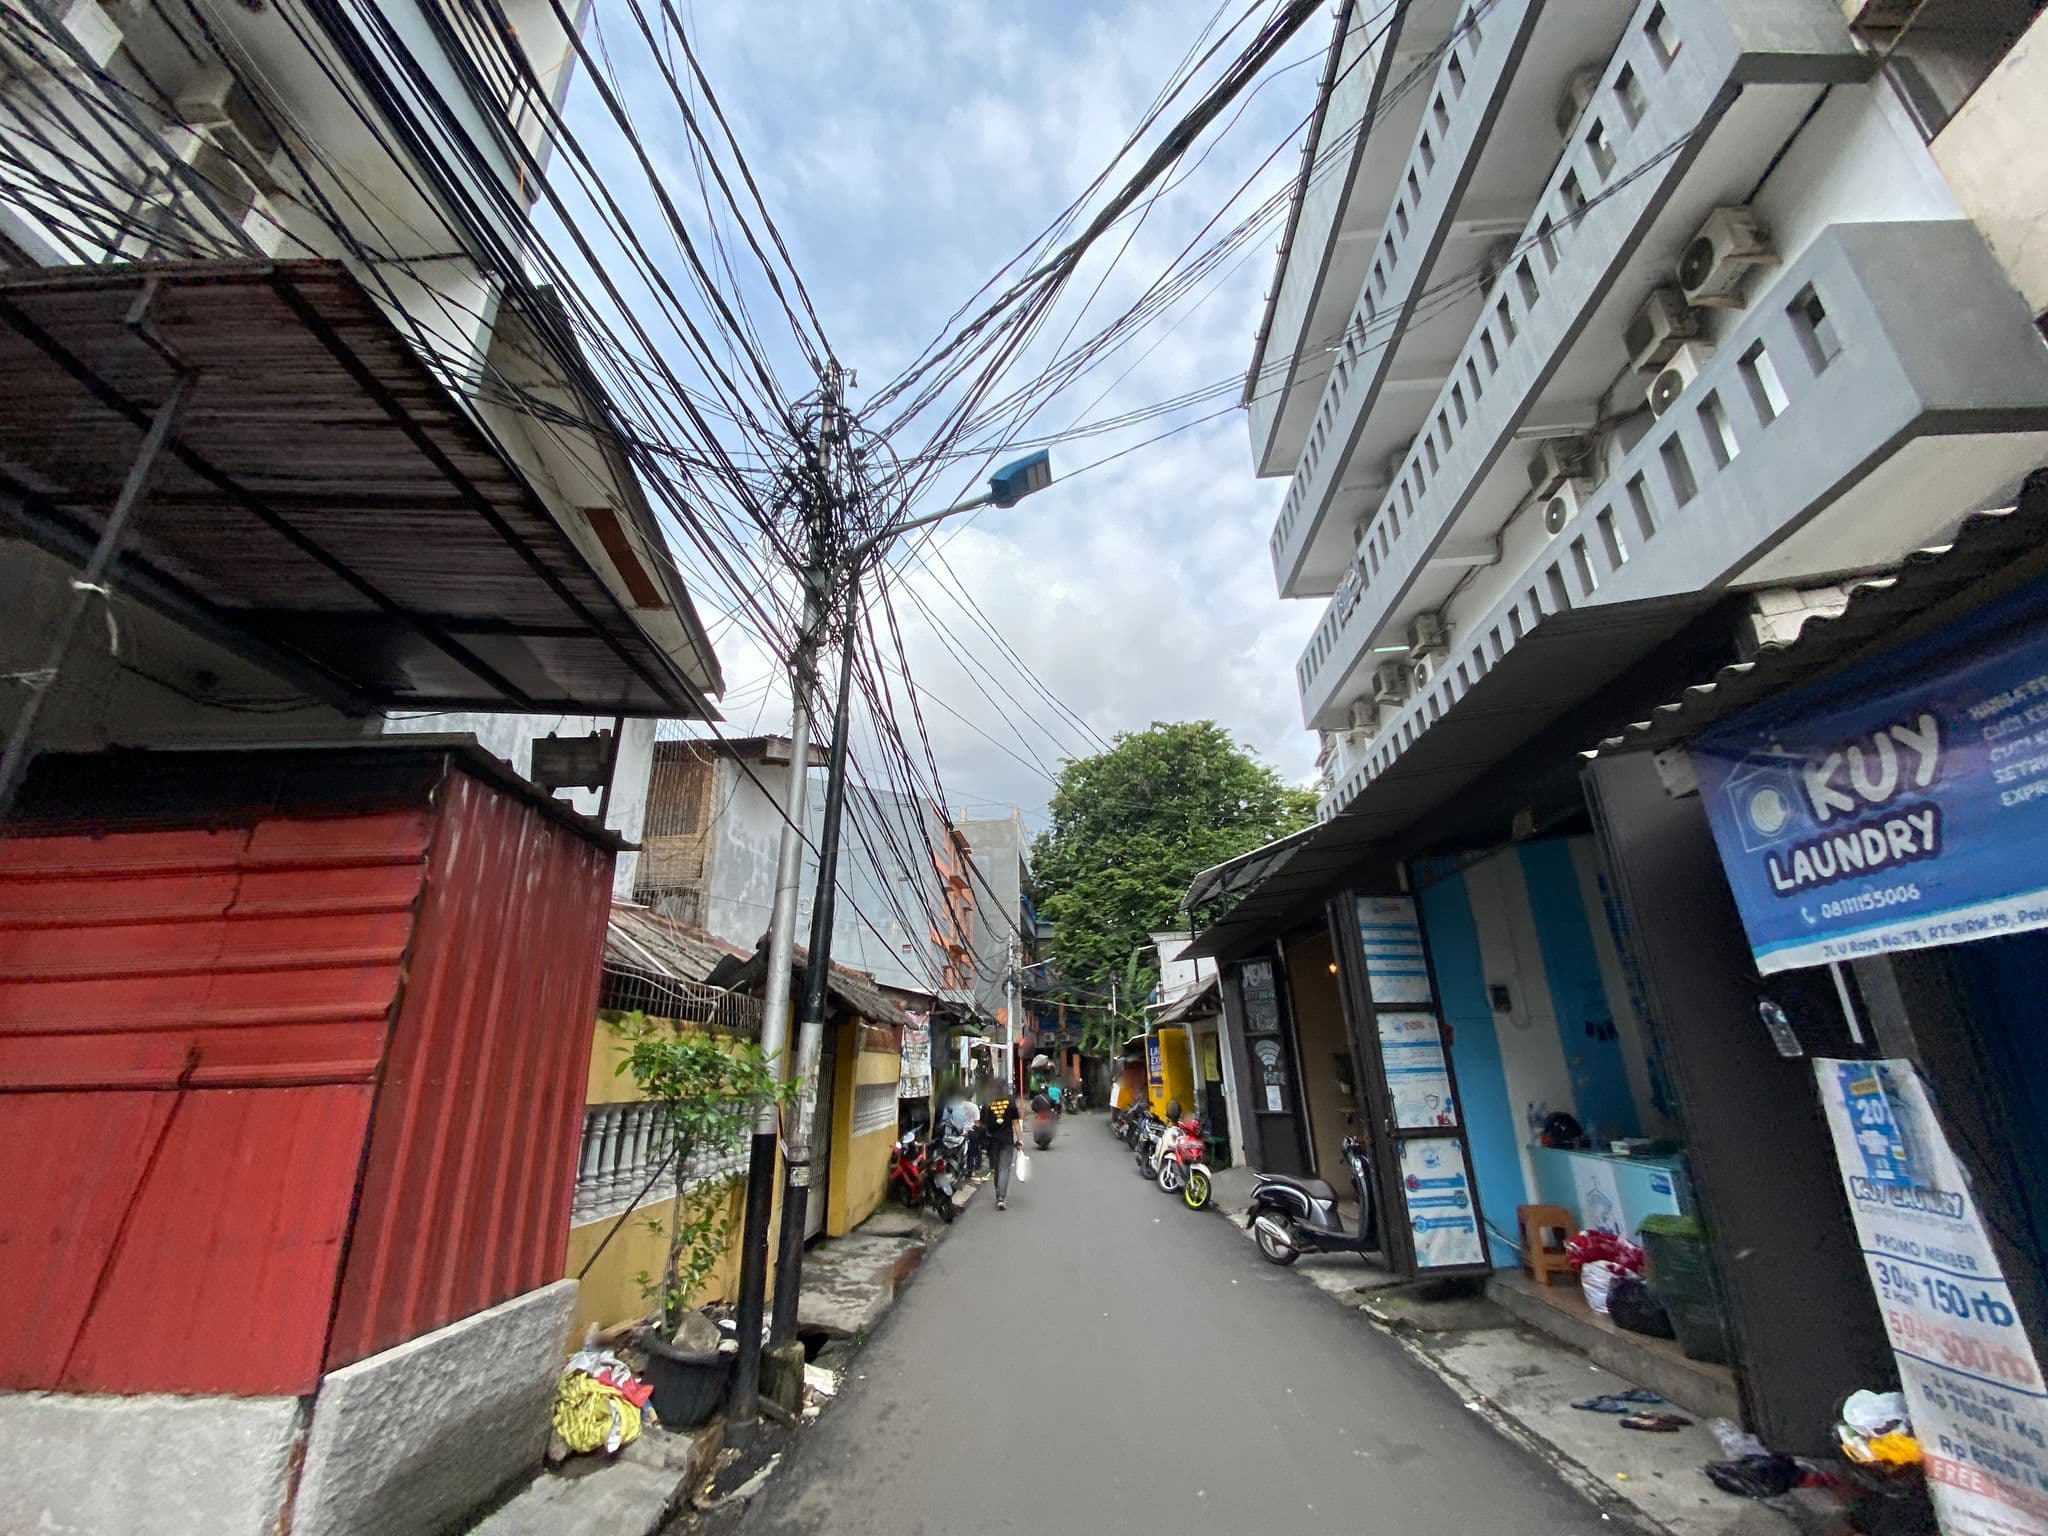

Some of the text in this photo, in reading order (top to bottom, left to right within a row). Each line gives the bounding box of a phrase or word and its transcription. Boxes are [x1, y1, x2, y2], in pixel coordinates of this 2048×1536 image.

[1803, 714, 1938, 822] KUY
[1768, 810, 1934, 891] LAUNDRY
[1874, 1233, 1979, 1271] PROMO MEMBER
[1921, 1275, 1970, 1319] 150
[1970, 1290, 2015, 1328] rb
[1938, 1434, 1968, 1461] Rp
[1932, 1461, 1985, 1494] FREE
